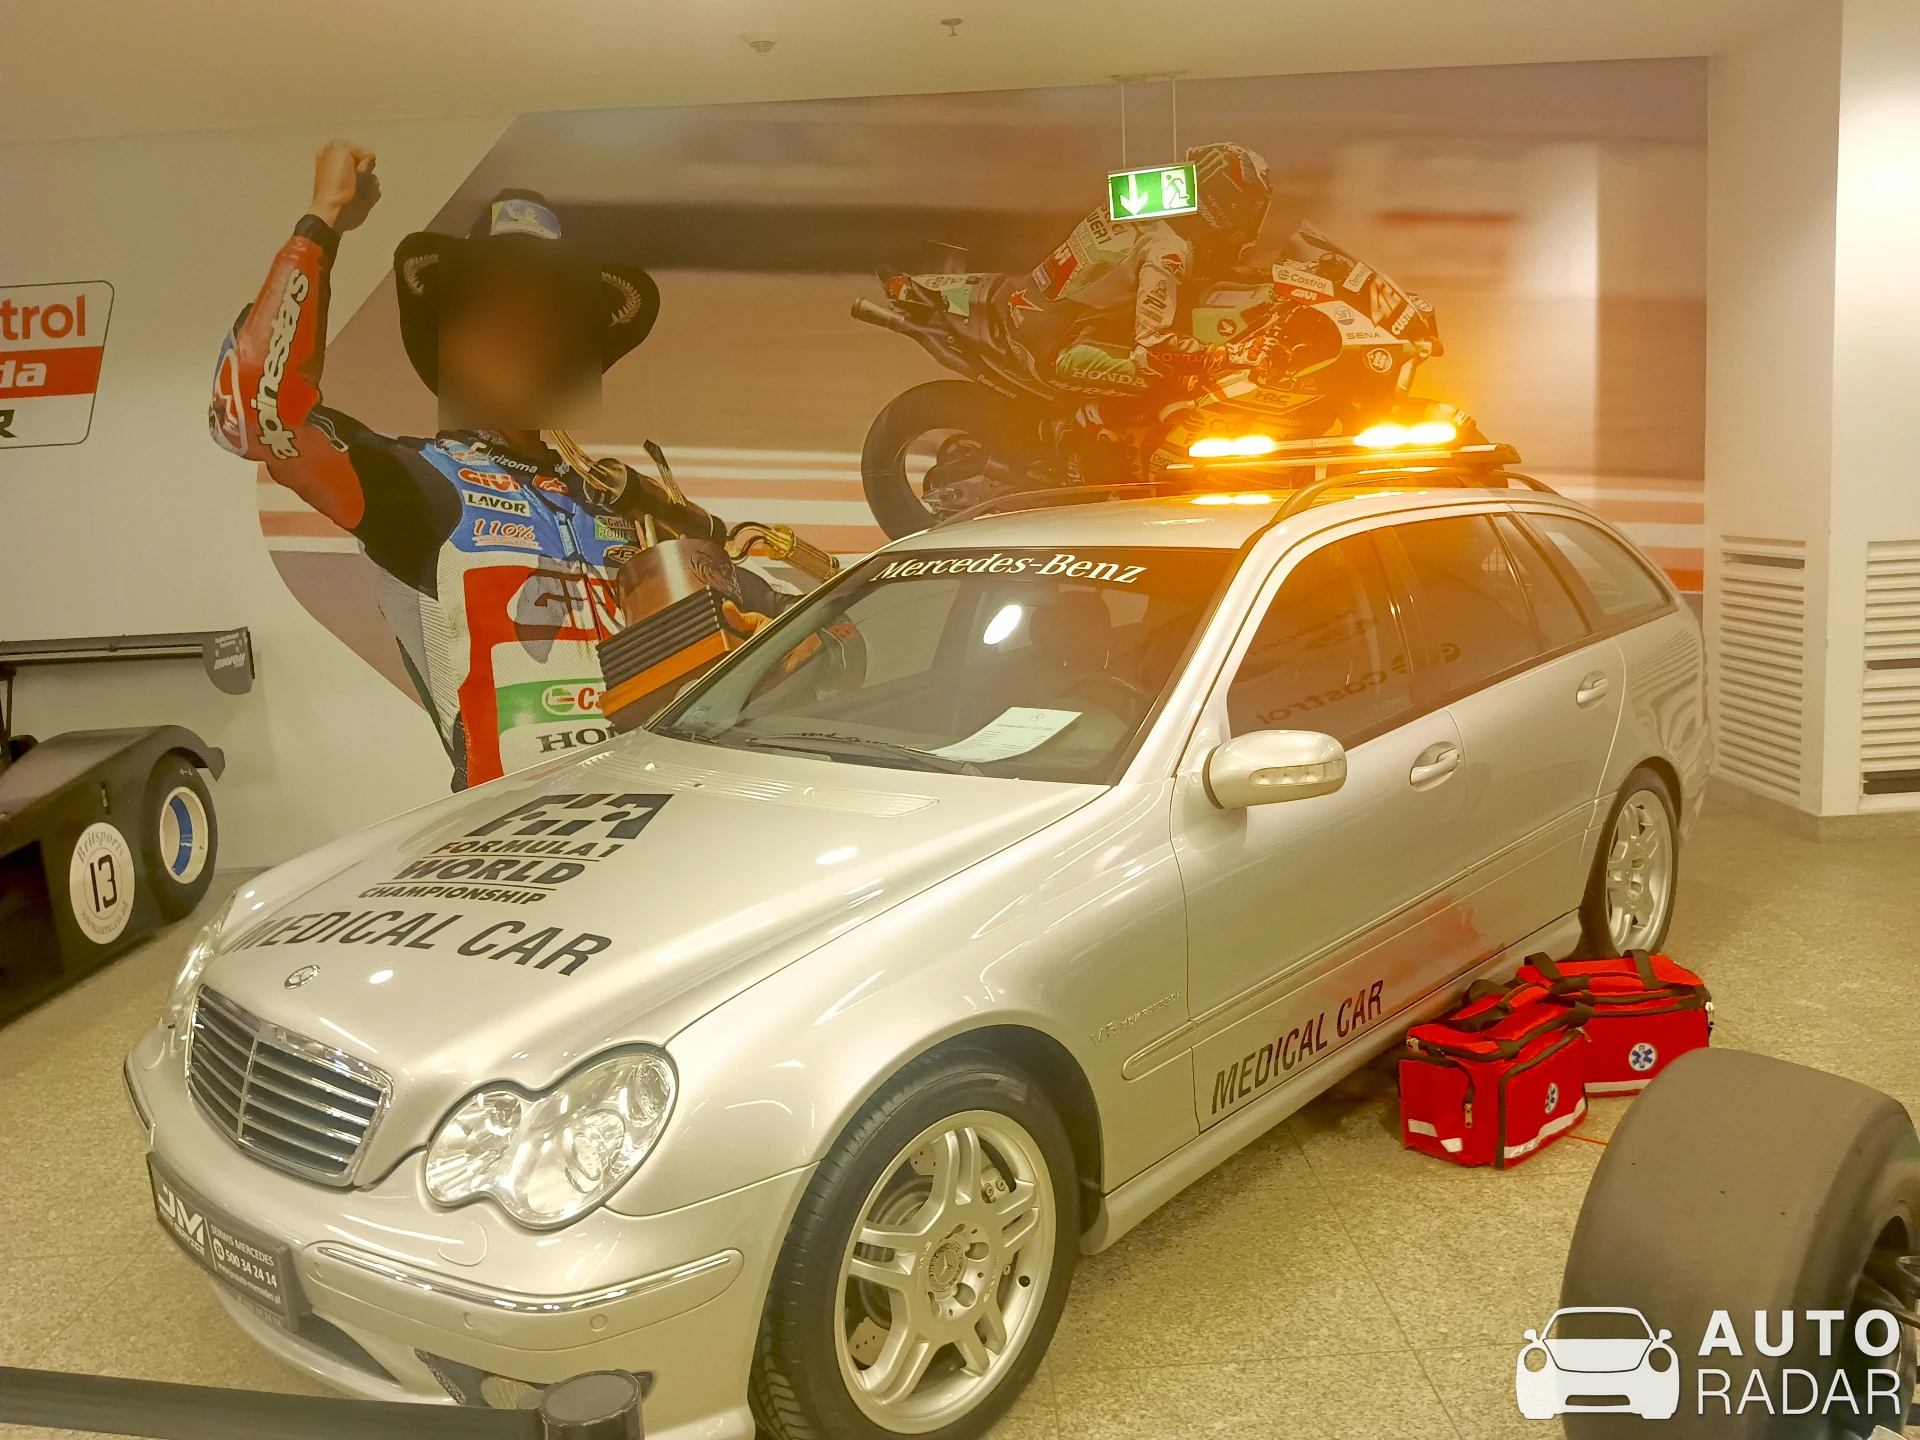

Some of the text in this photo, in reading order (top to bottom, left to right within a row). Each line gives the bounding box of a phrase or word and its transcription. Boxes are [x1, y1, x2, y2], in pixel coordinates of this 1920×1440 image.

[1290, 273, 1327, 290] Castrol
[1346, 331, 1381, 340] SENA
[250, 267, 309, 460] alpinestars
[1071, 367, 1148, 389] HONDA
[490, 454, 538, 474] rizoma
[458, 468, 521, 493] GIVI
[467, 493, 528, 515] LAVOR
[473, 518, 536, 541] 110%
[868, 552, 1148, 584] Mercedes-Benz
[76, 829, 126, 864] Britsports
[429, 839, 625, 858] FORMULA 1
[89, 853, 118, 913] 13
[392, 858, 586, 885] WORLD
[357, 886, 548, 905] CHAMPIONSHIP
[220, 909, 613, 977] MEDICAL CAR
[1211, 979, 1384, 1115] MEDICAL CAR
[157, 1183, 205, 1246] JM
[210, 1224, 275, 1267] SERWIS MERCEDES
[225, 1249, 278, 1288] 500 34 24 14
